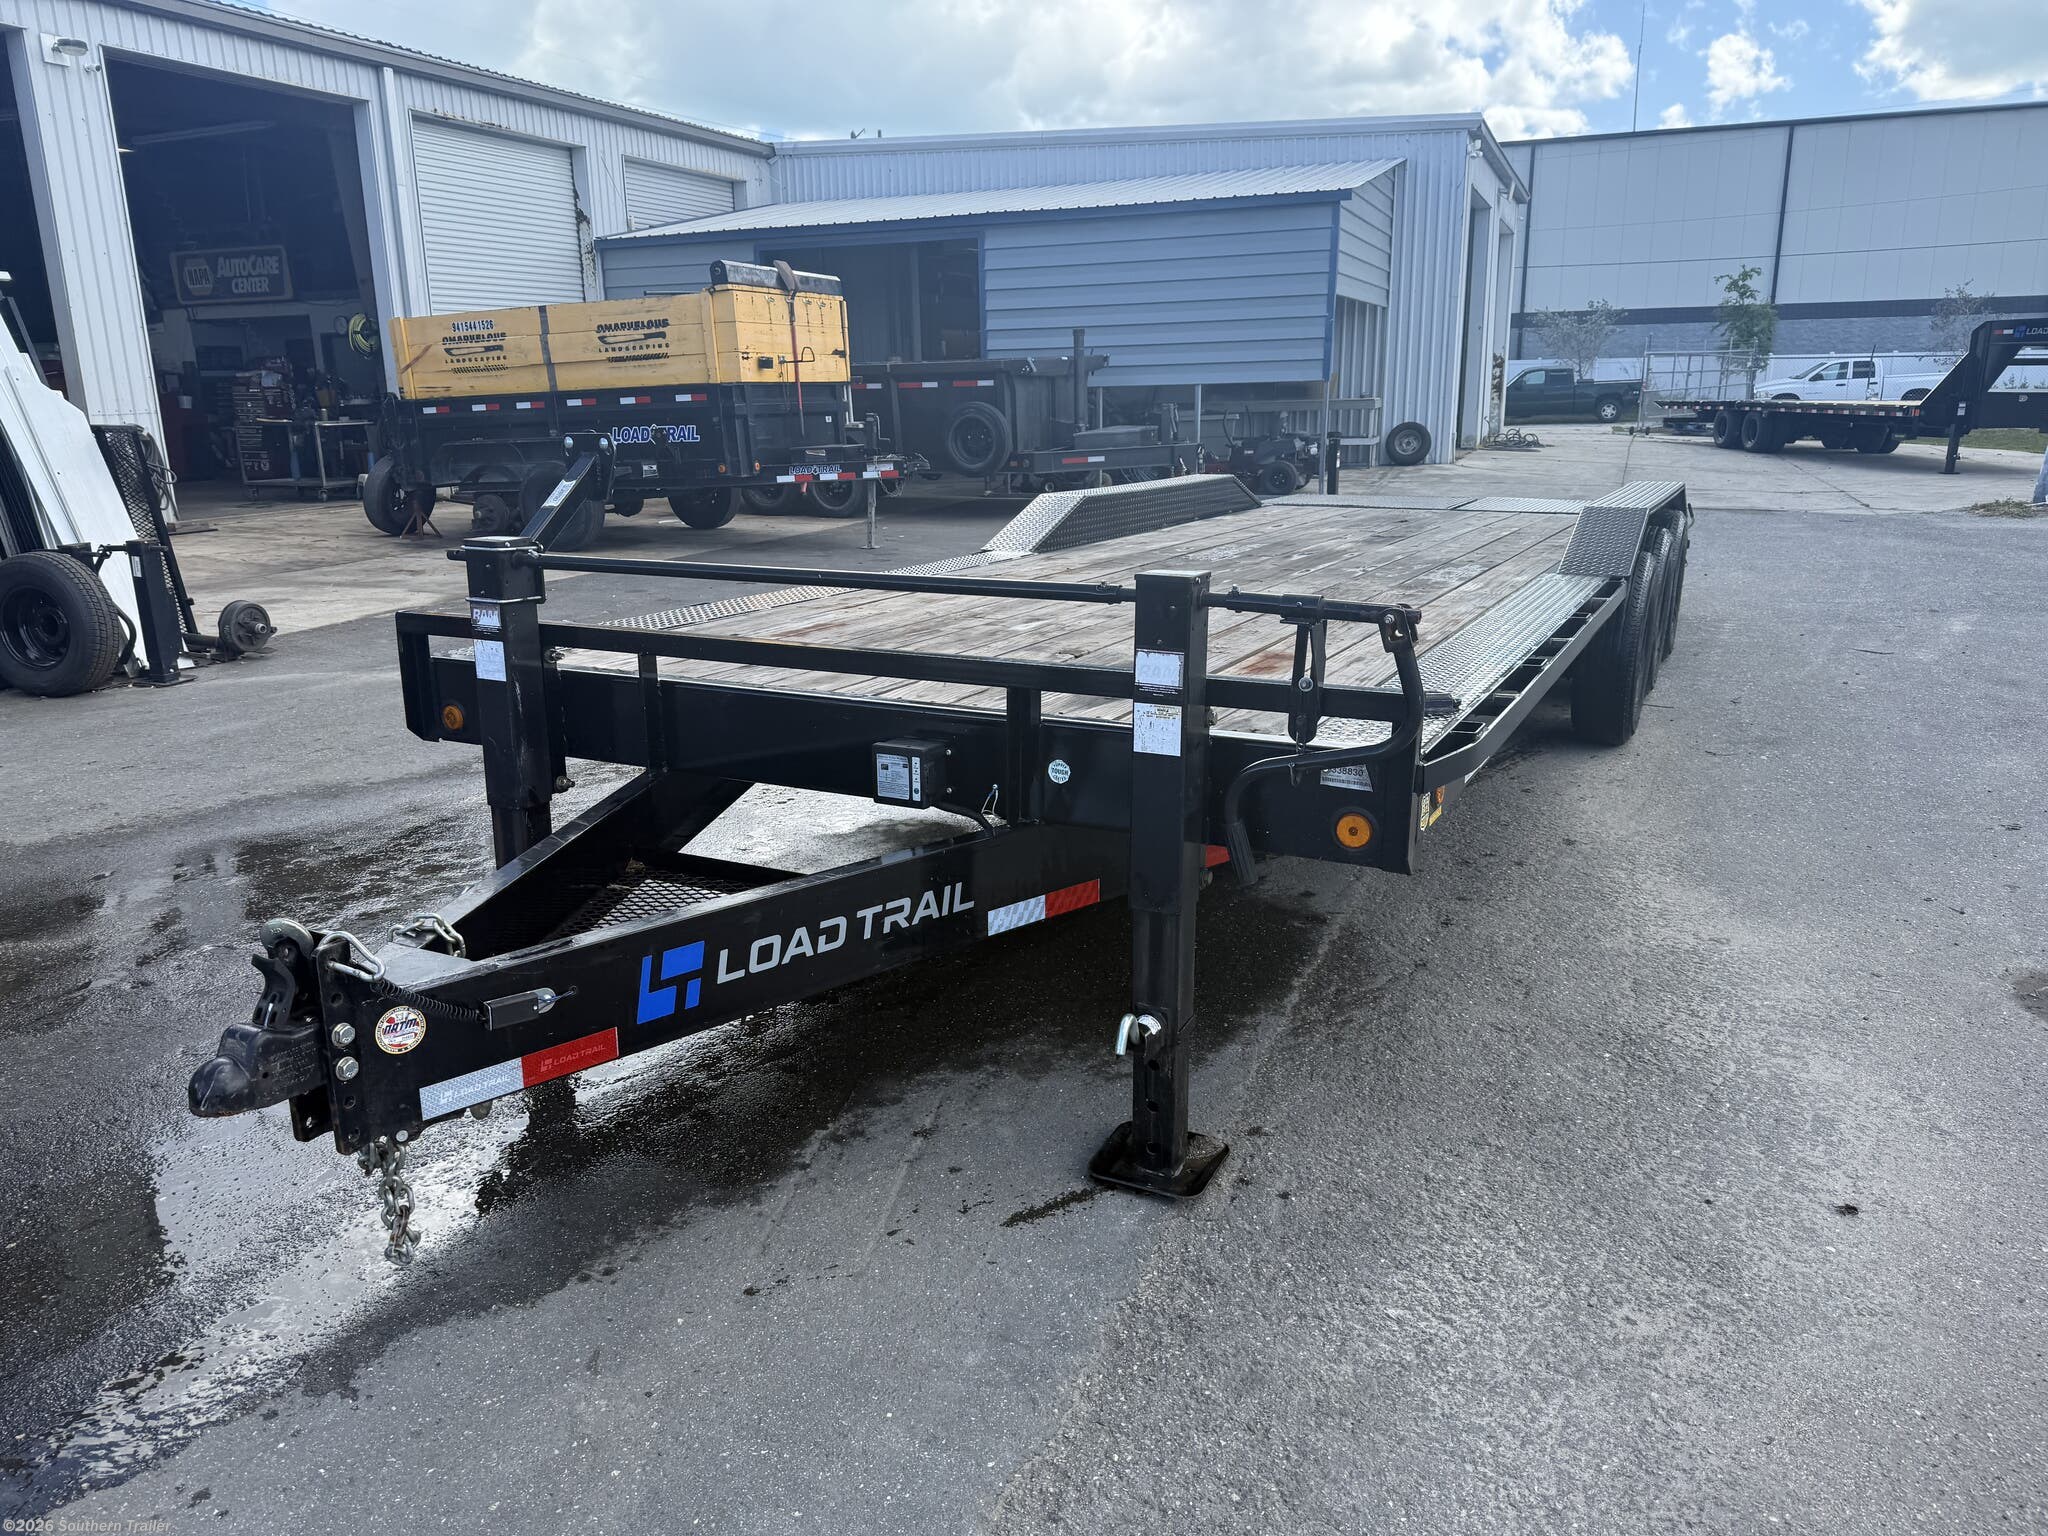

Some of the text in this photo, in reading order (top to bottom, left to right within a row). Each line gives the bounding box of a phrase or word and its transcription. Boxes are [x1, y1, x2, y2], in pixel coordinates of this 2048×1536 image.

[185, 267, 212, 288] NAPA
[231, 277, 269, 294] CENTER
[451, 319, 495, 333] 9415441526
[598, 342, 670, 353] LANDSCAPING
[444, 355, 508, 364] LANDSCAPING
[612, 425, 700, 443] LOAD RAIL
[789, 464, 841, 475] LOAD TRAIL
[716, 915, 848, 985] LOAD
[856, 881, 976, 941] TRAIL
[553, 1044, 606, 1066] LOAD TRAIL
